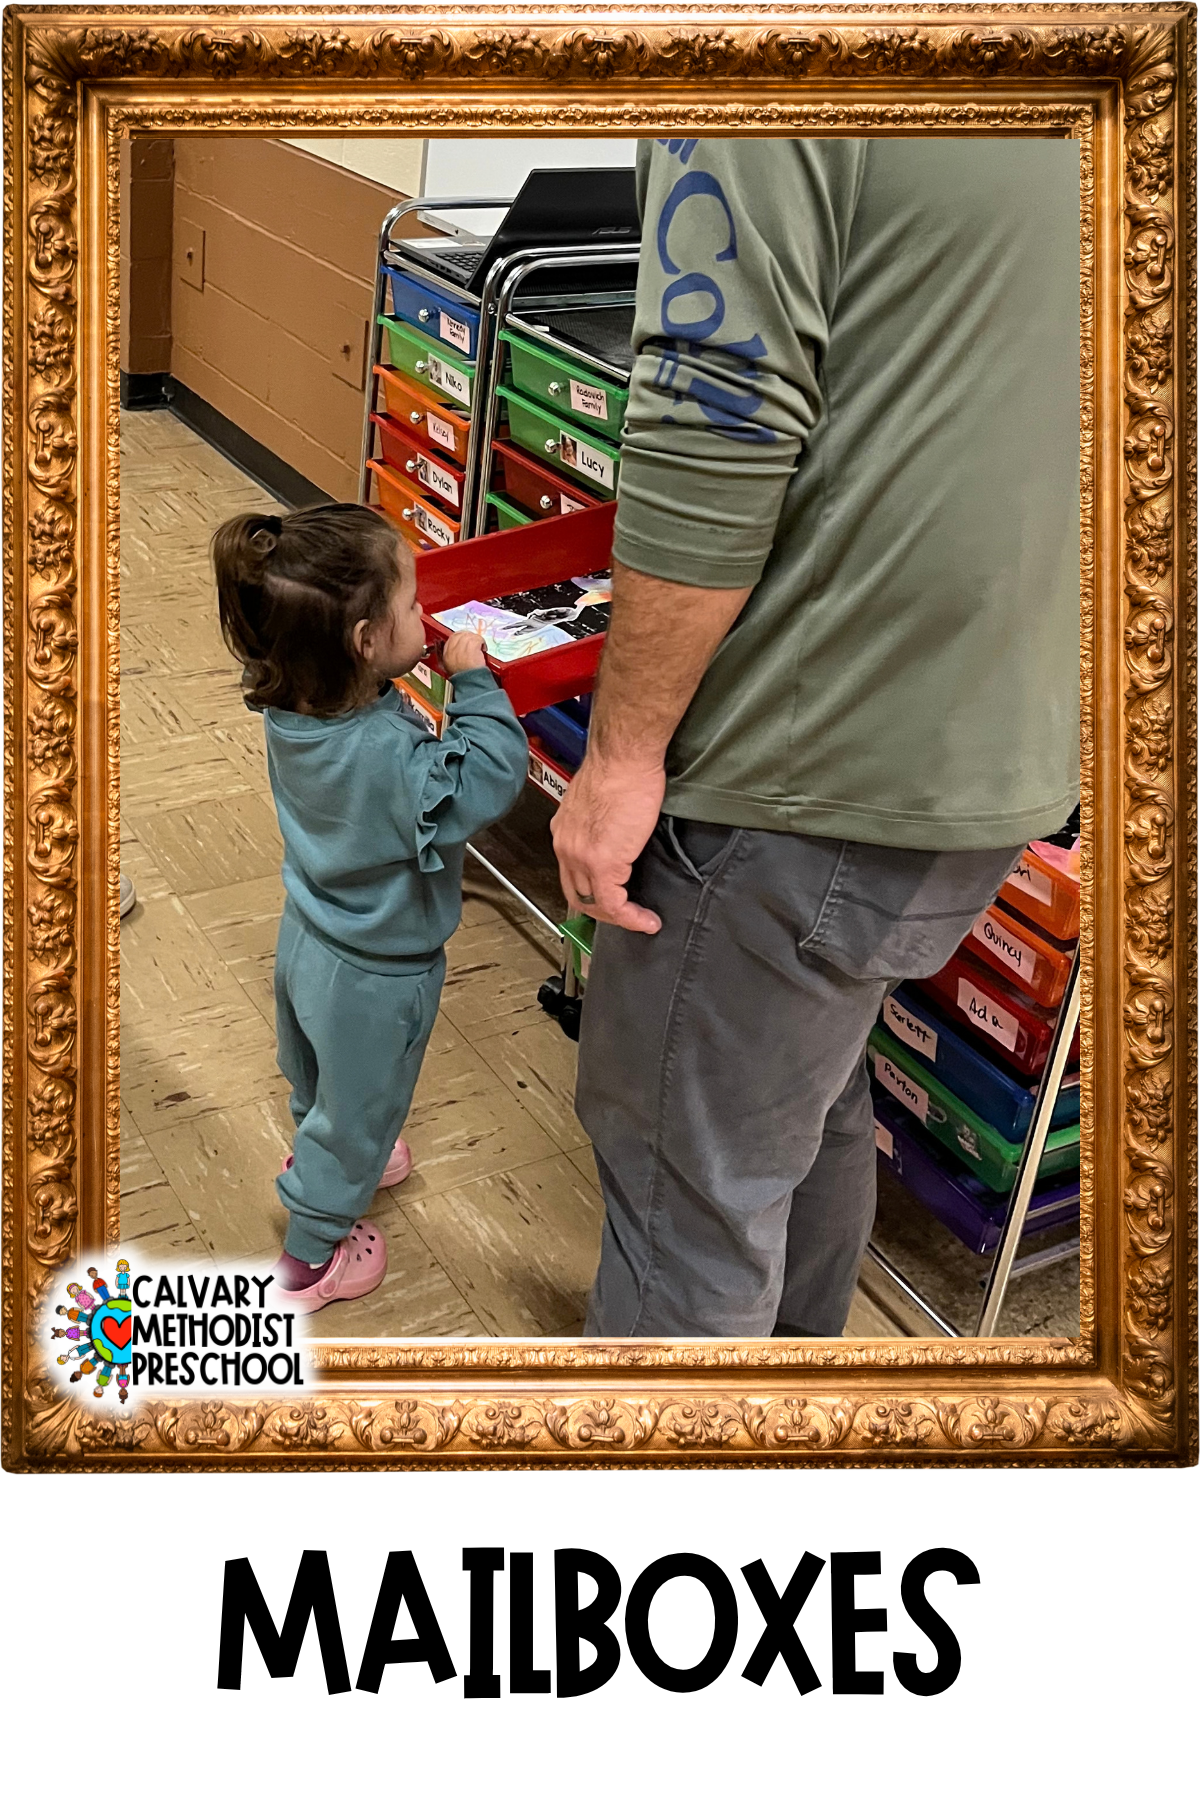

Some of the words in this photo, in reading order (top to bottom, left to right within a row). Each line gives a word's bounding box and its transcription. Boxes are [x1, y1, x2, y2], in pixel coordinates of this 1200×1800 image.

[445, 371, 463, 392] Niko
[581, 398, 602, 415] Family
[581, 450, 604, 478] Lucy
[432, 470, 453, 494] Dylan
[427, 517, 450, 545] Rocky
[543, 771, 567, 797] Abig
[983, 922, 1022, 968] Quincy
